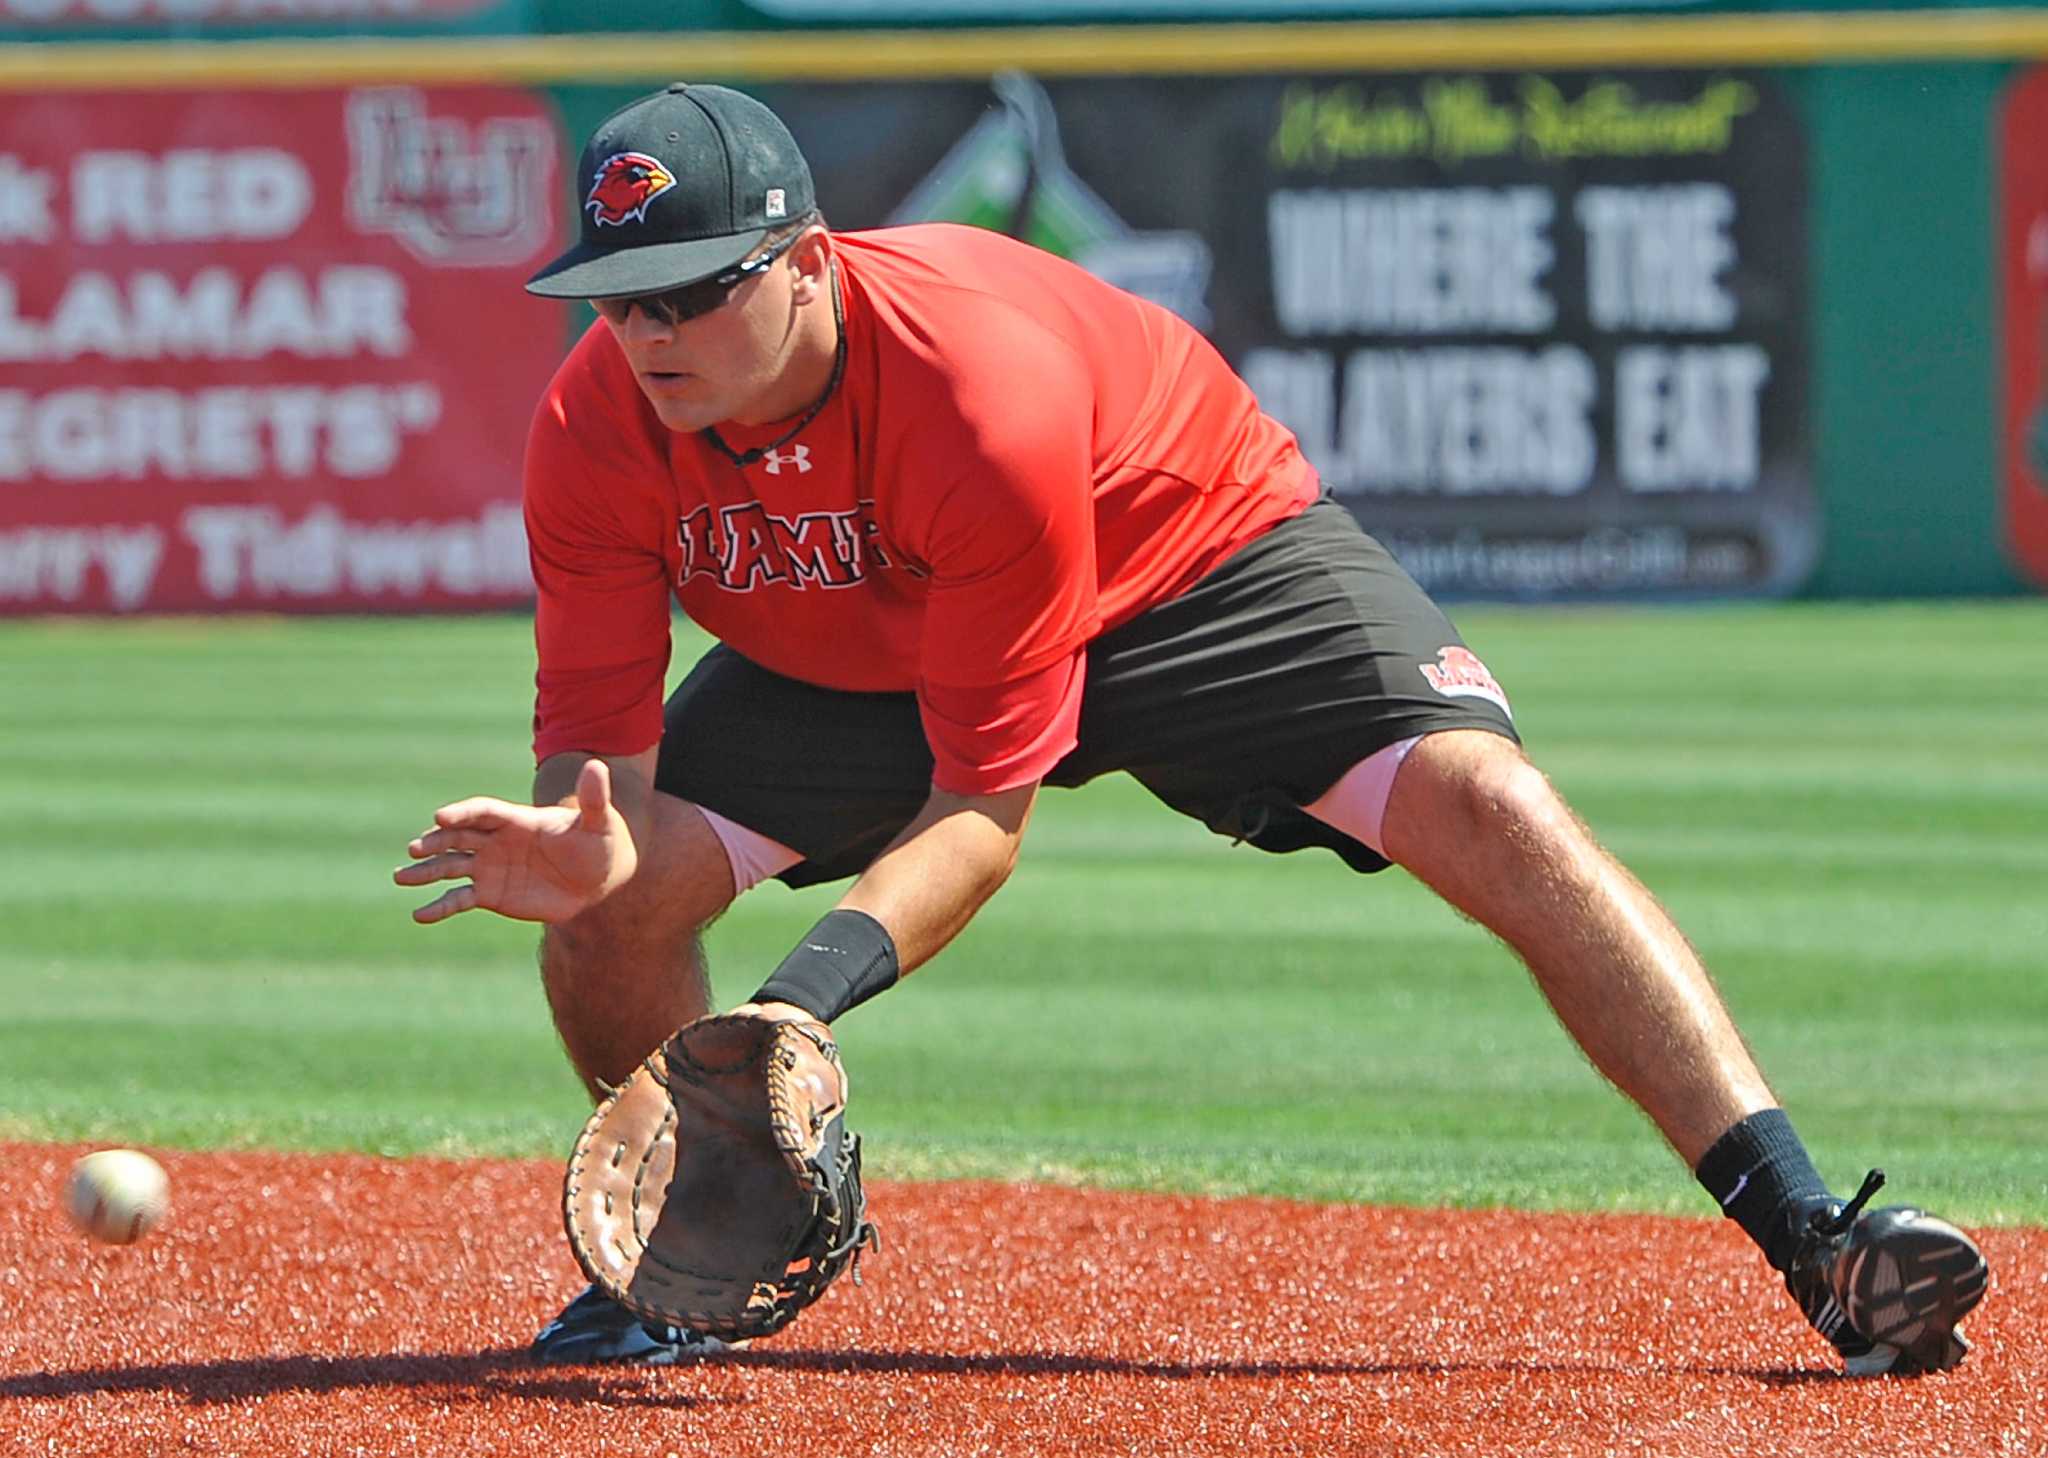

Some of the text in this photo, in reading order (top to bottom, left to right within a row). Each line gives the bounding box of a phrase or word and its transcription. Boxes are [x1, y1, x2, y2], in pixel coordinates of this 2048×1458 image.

[70, 148, 312, 243] RED
[0, 264, 408, 361] LAMAR
[1268, 185, 1558, 337] WHERE
[1572, 181, 1740, 334] THE
[1612, 344, 1774, 495] EAT
